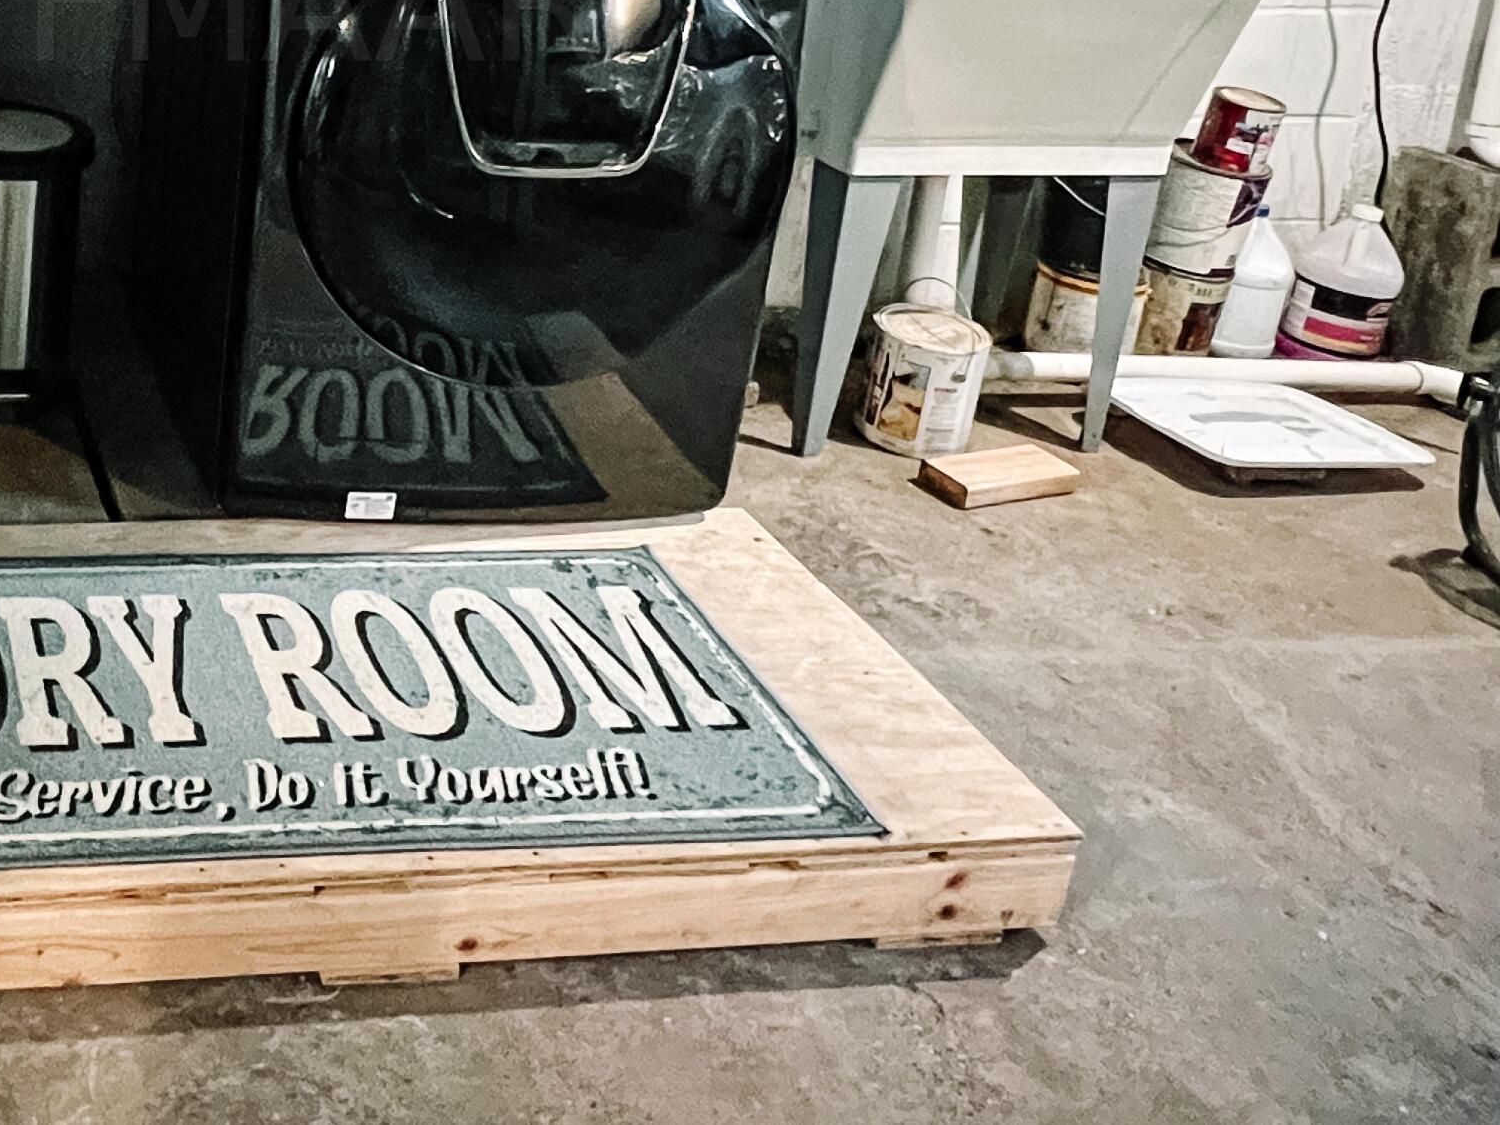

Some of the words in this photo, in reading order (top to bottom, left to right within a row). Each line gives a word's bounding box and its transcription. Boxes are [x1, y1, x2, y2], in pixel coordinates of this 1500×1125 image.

[218, 585, 750, 744] ROOM
[242, 757, 316, 812] Do
[397, 746, 658, 801] Yourself!
